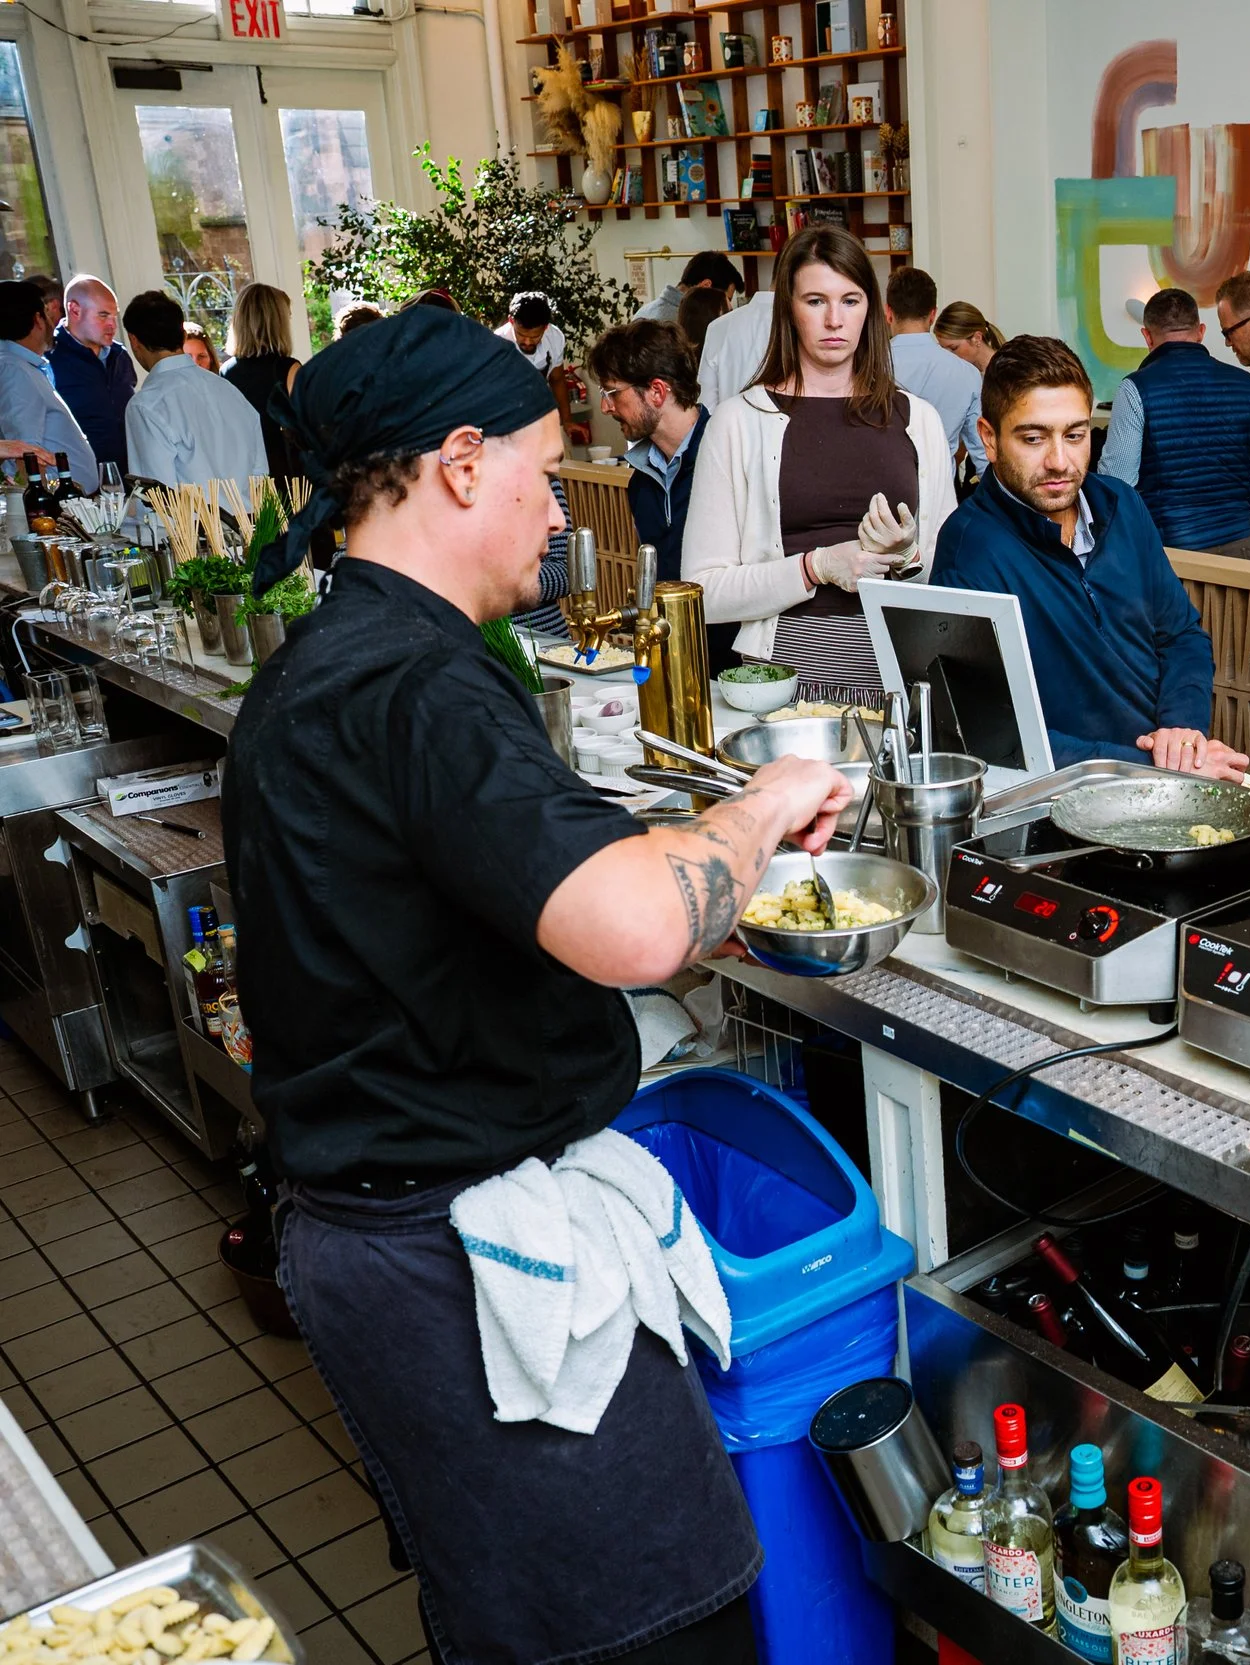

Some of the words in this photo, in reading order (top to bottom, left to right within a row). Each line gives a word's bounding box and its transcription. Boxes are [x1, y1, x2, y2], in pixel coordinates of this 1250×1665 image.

[229, 0, 280, 38] EXIT
[128, 785, 179, 800] Companions
[168, 791, 186, 799] GLOVES
[1034, 901, 1057, 917] 20
[1200, 938, 1233, 955] CookTek
[990, 1568, 1034, 1588] ITTER
[1056, 1589, 1111, 1626] INGLETON
[1091, 1645, 1109, 1653] OLD
[1126, 1655, 1174, 1665] BITTE
